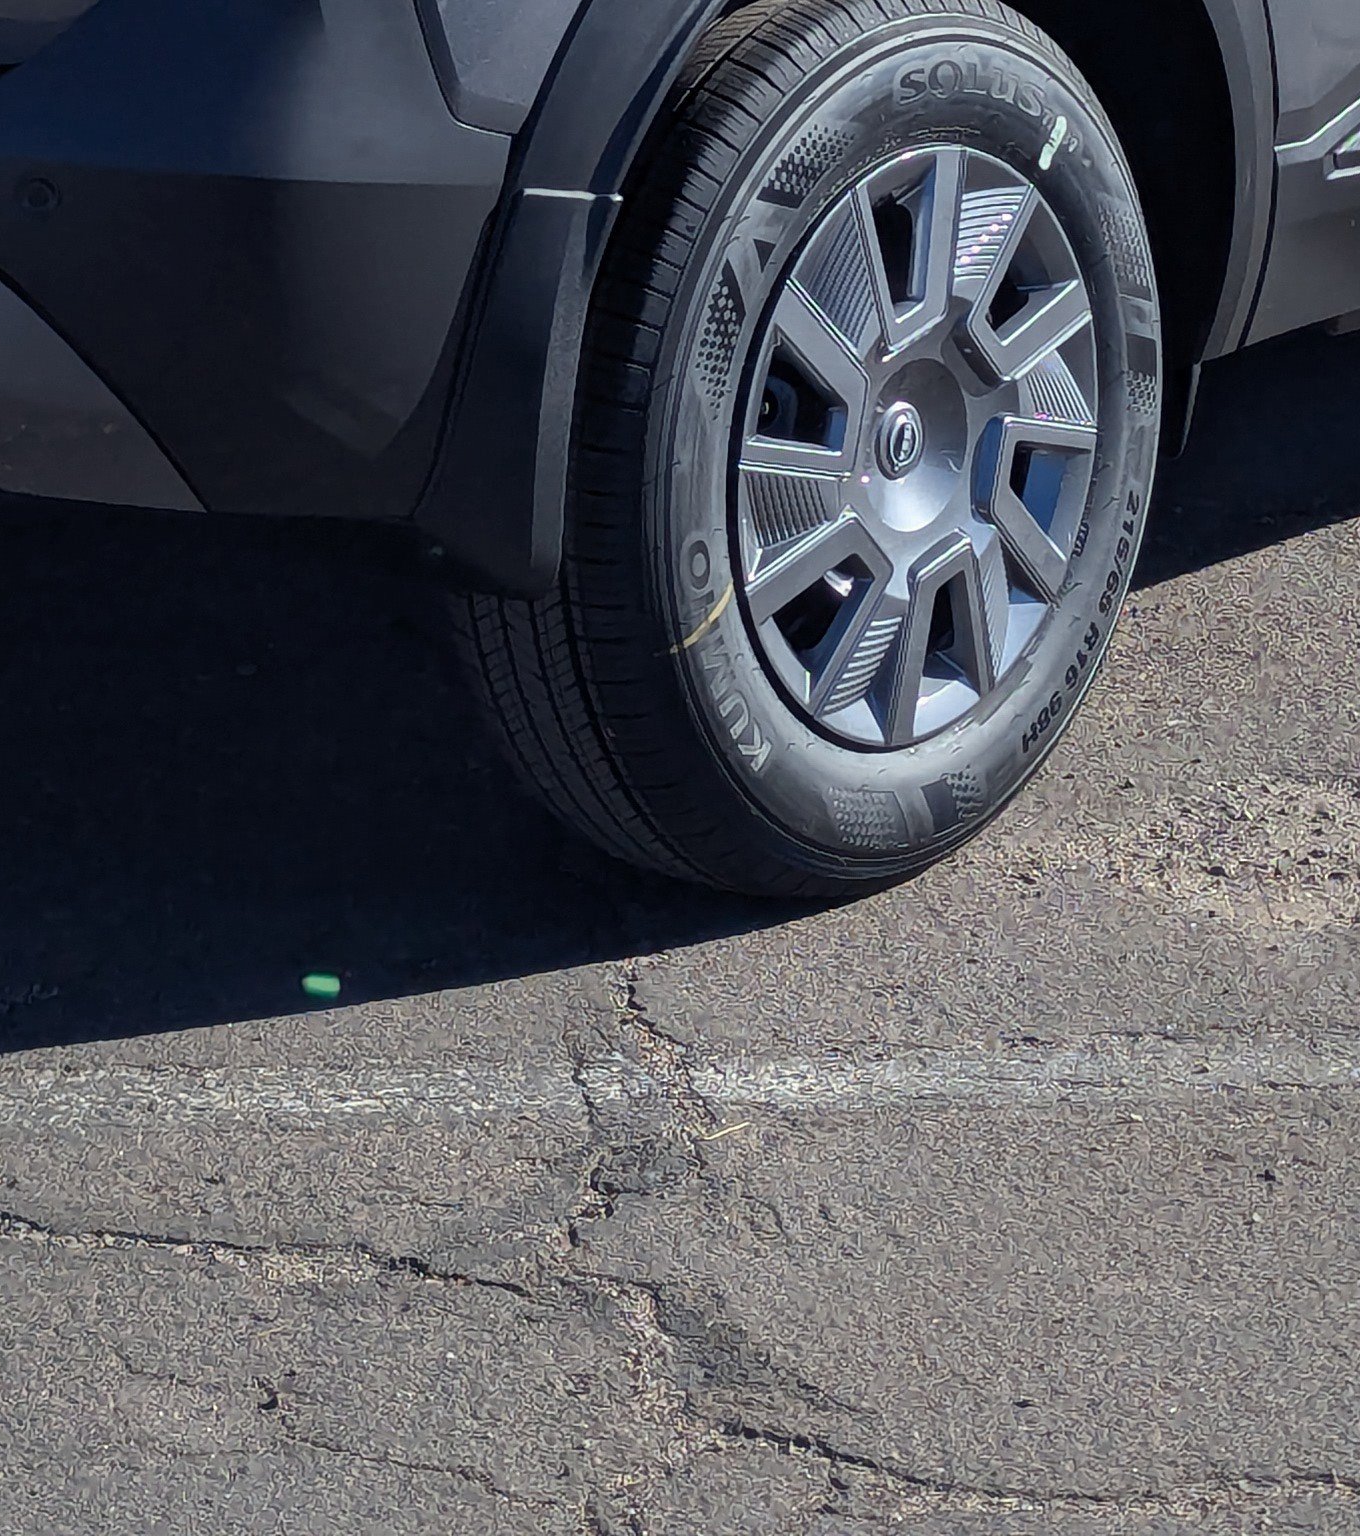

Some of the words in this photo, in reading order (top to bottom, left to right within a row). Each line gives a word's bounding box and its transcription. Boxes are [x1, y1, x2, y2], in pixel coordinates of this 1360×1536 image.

[897, 58, 1046, 118] SOLUS
[1096, 489, 1141, 617] 215/65
[687, 538, 773, 773] KUMHO
[1064, 620, 1100, 691] R16
